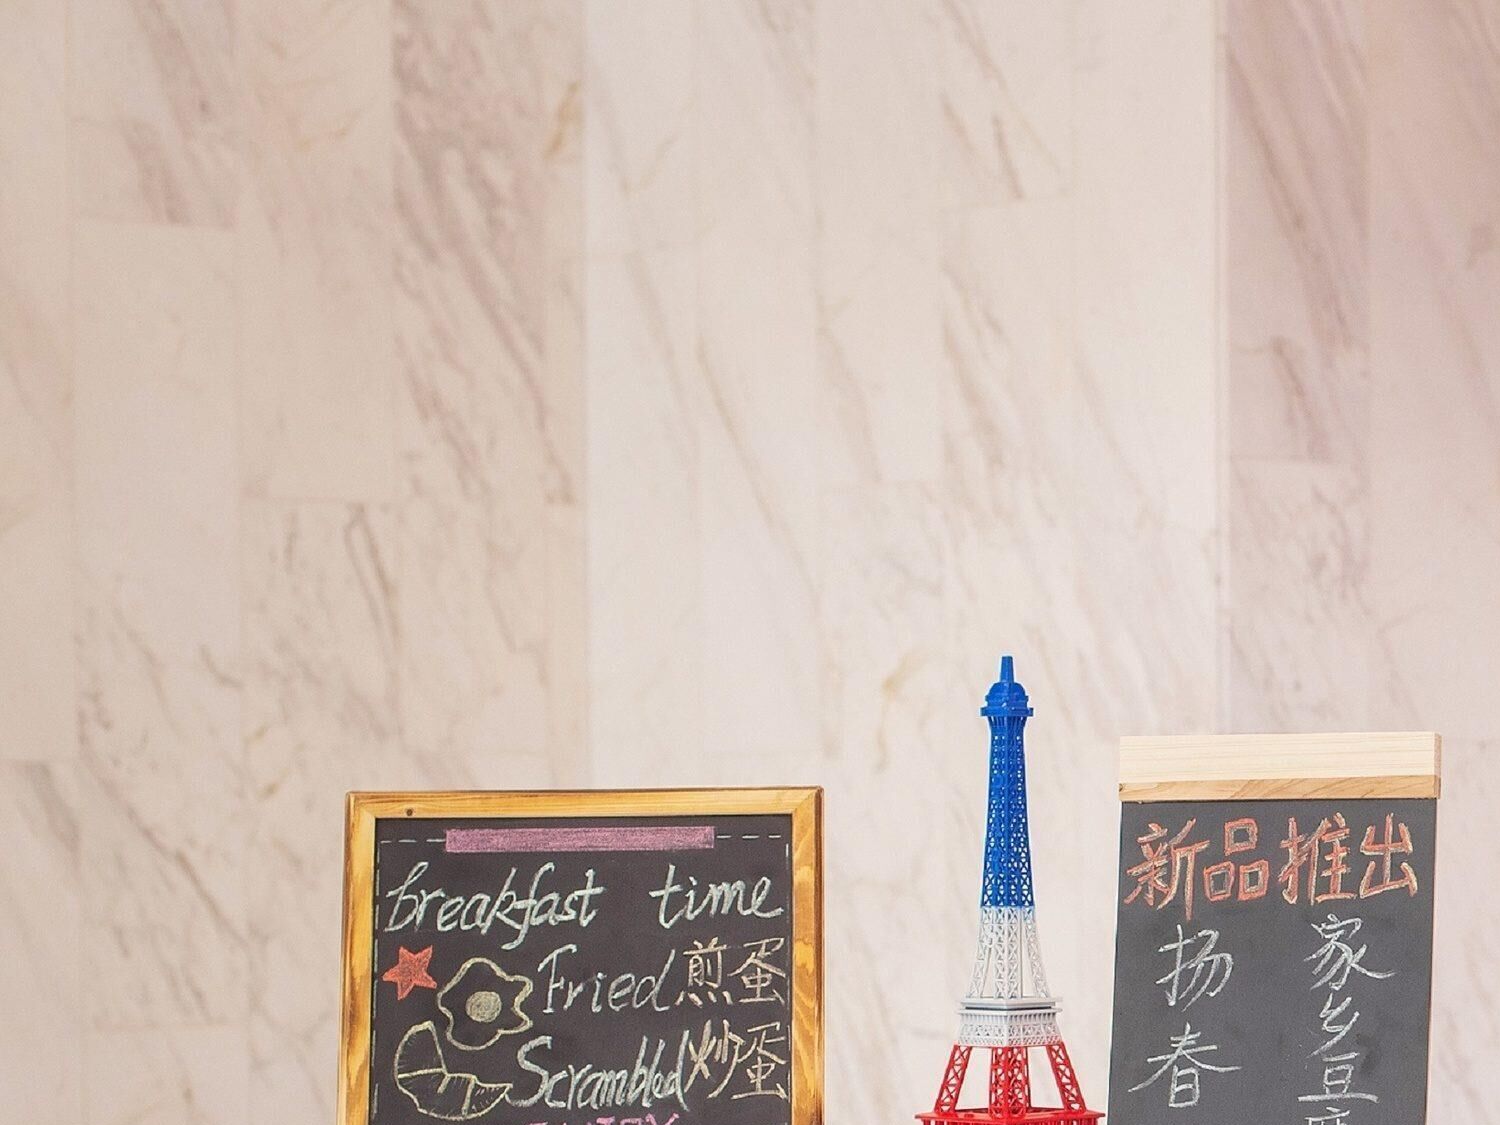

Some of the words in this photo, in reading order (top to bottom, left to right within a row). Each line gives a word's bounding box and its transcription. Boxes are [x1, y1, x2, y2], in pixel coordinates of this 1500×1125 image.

[383, 861, 606, 950] breakfast
[649, 864, 785, 930] time
[1123, 811, 1419, 921] 新品推出
[537, 944, 676, 1014] Fried
[674, 937, 787, 1007] 煎蛋
[506, 1029, 690, 1112] Scrambled
[683, 1019, 788, 1100] 炒蛋
